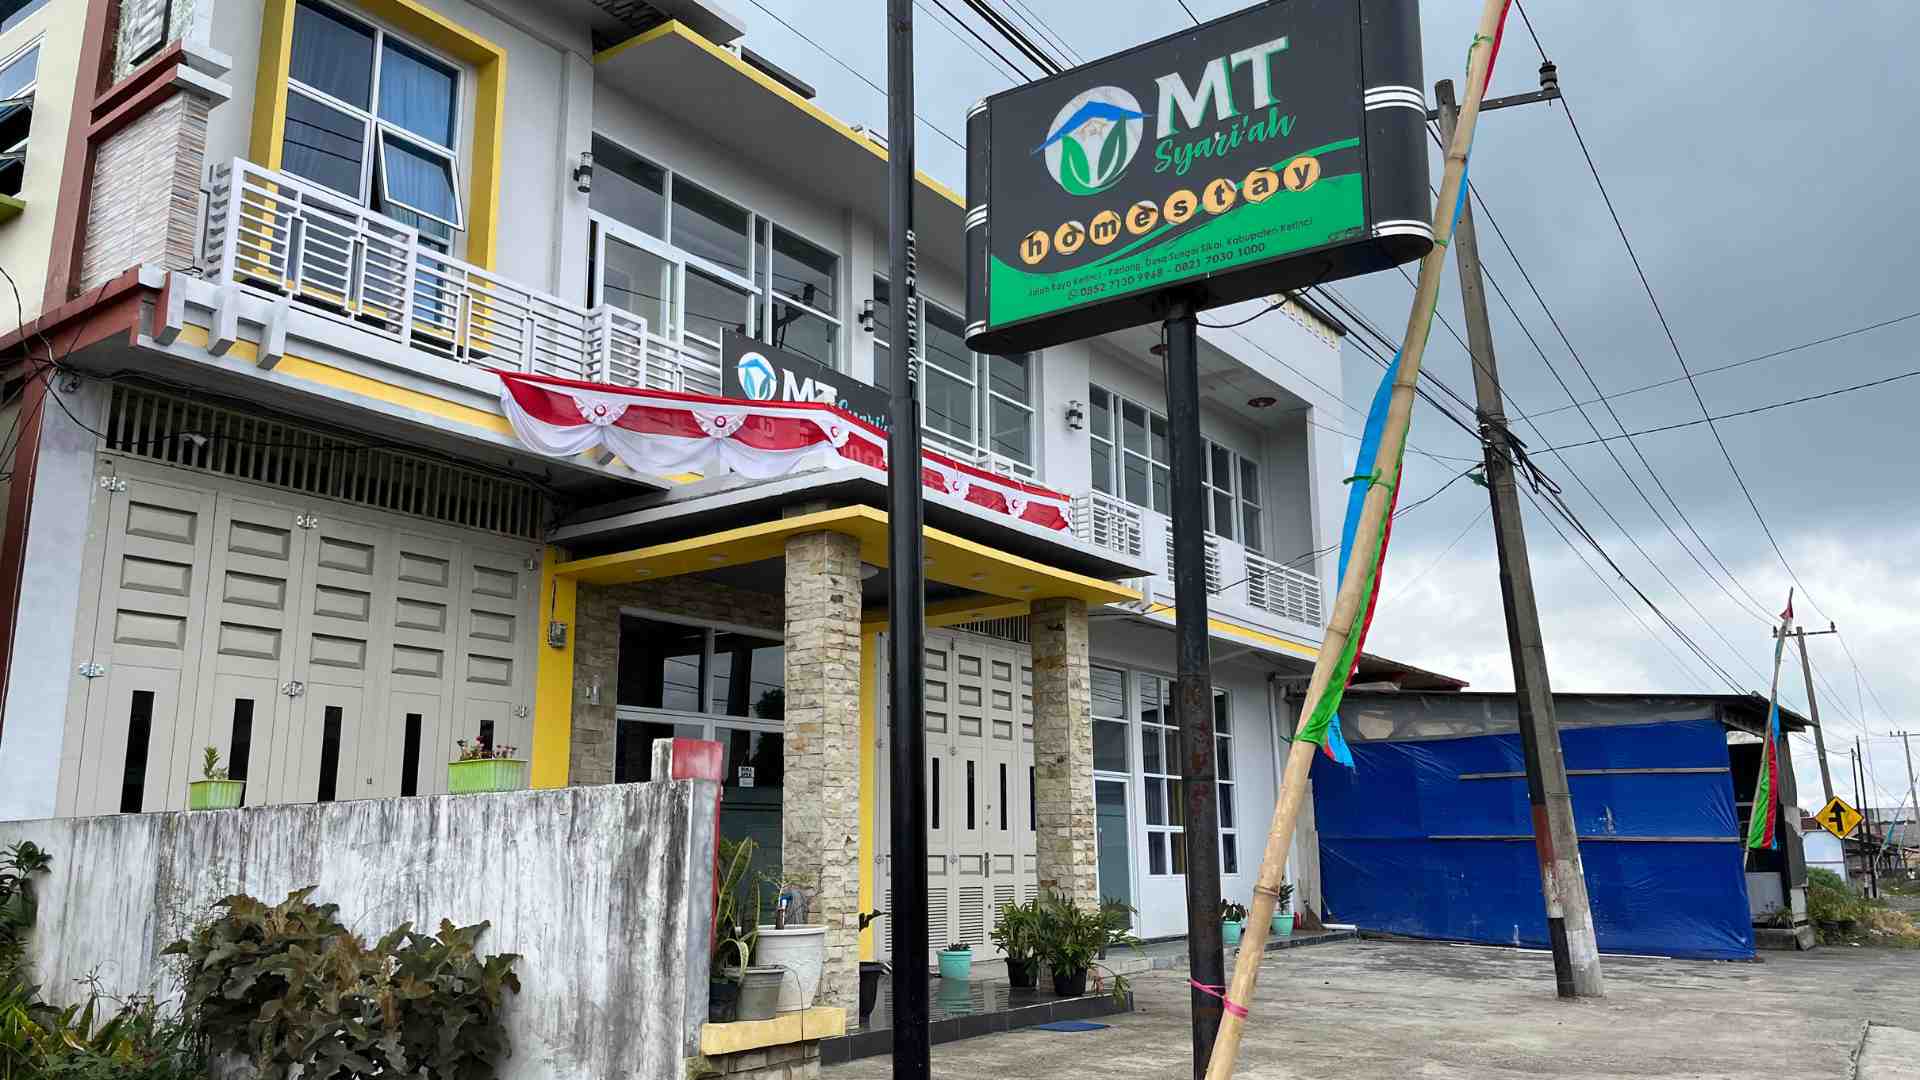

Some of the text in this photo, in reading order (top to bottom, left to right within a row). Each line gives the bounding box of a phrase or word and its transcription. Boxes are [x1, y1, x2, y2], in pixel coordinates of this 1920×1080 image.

[1154, 36, 1289, 139] MT
[1154, 106, 1296, 175] Syari'ah
[1022, 158, 1315, 260] homestay
[1238, 242, 1265, 257] 1000
